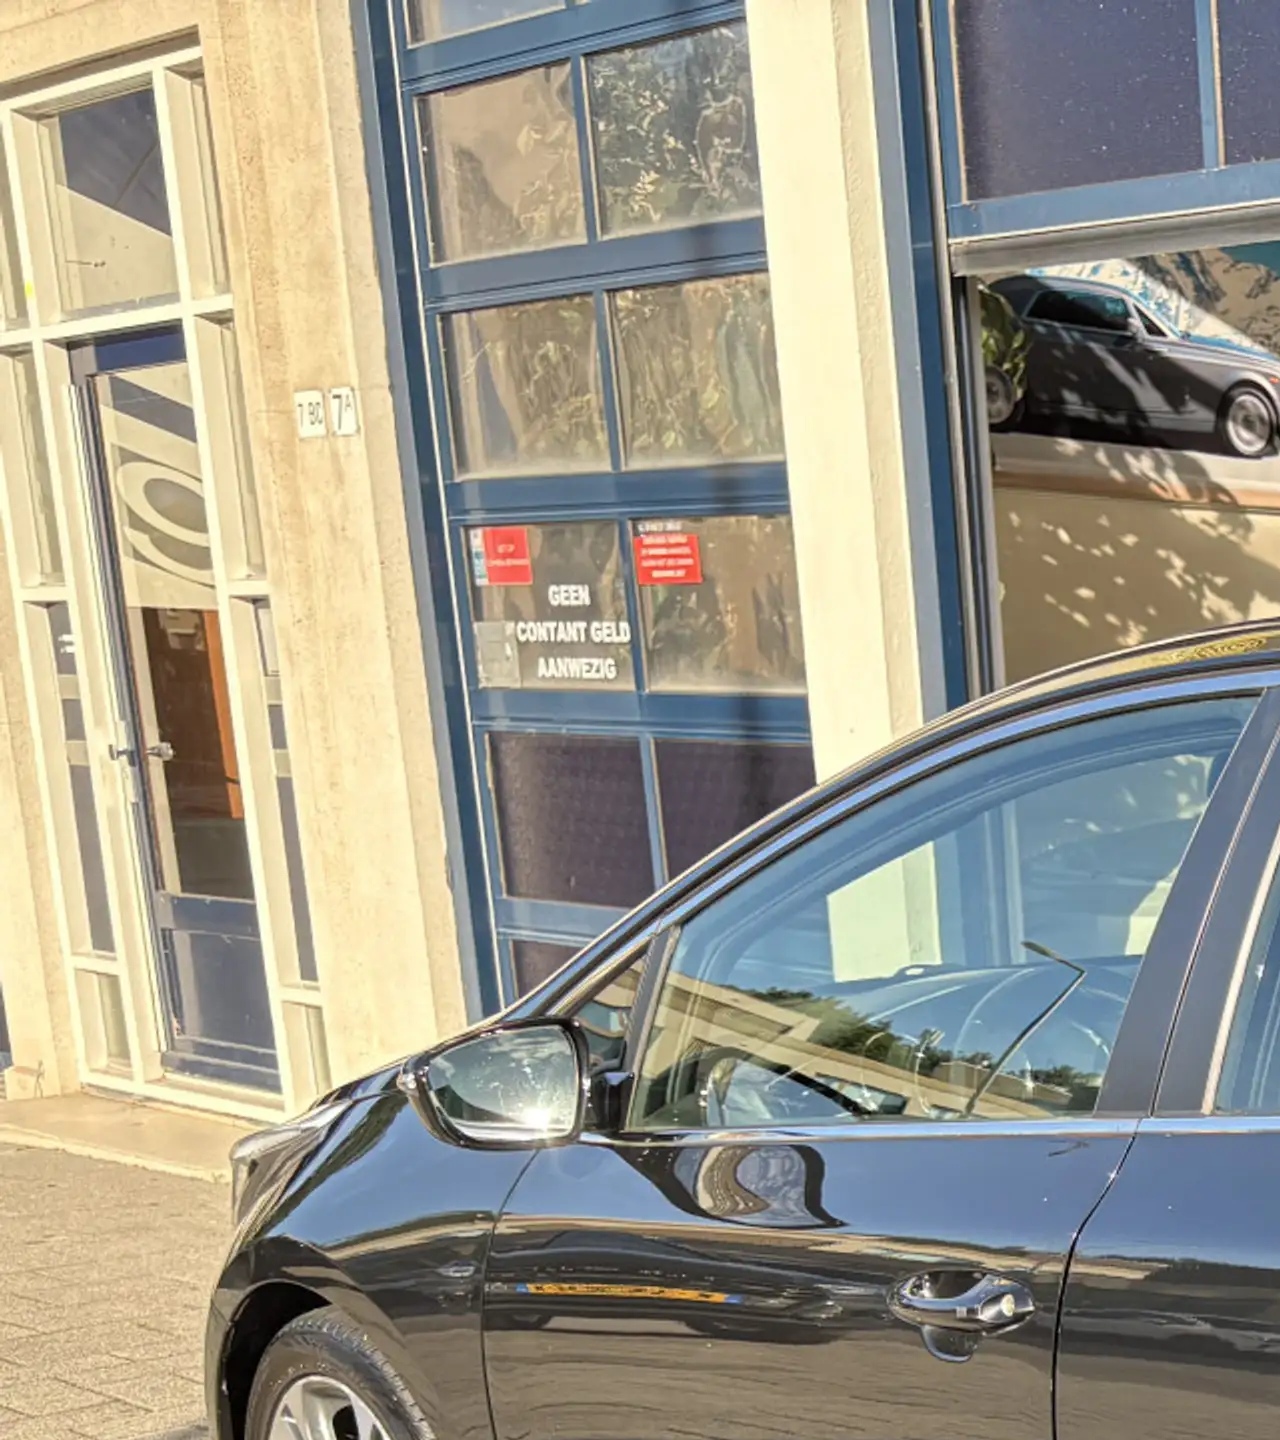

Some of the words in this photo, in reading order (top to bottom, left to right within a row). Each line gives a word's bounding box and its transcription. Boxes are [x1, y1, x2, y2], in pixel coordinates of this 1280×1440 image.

[548, 584, 591, 606] GEEN
[516, 620, 588, 643] CONTANT
[590, 621, 631, 644] GELD
[538, 656, 617, 680] AANWEZIG
